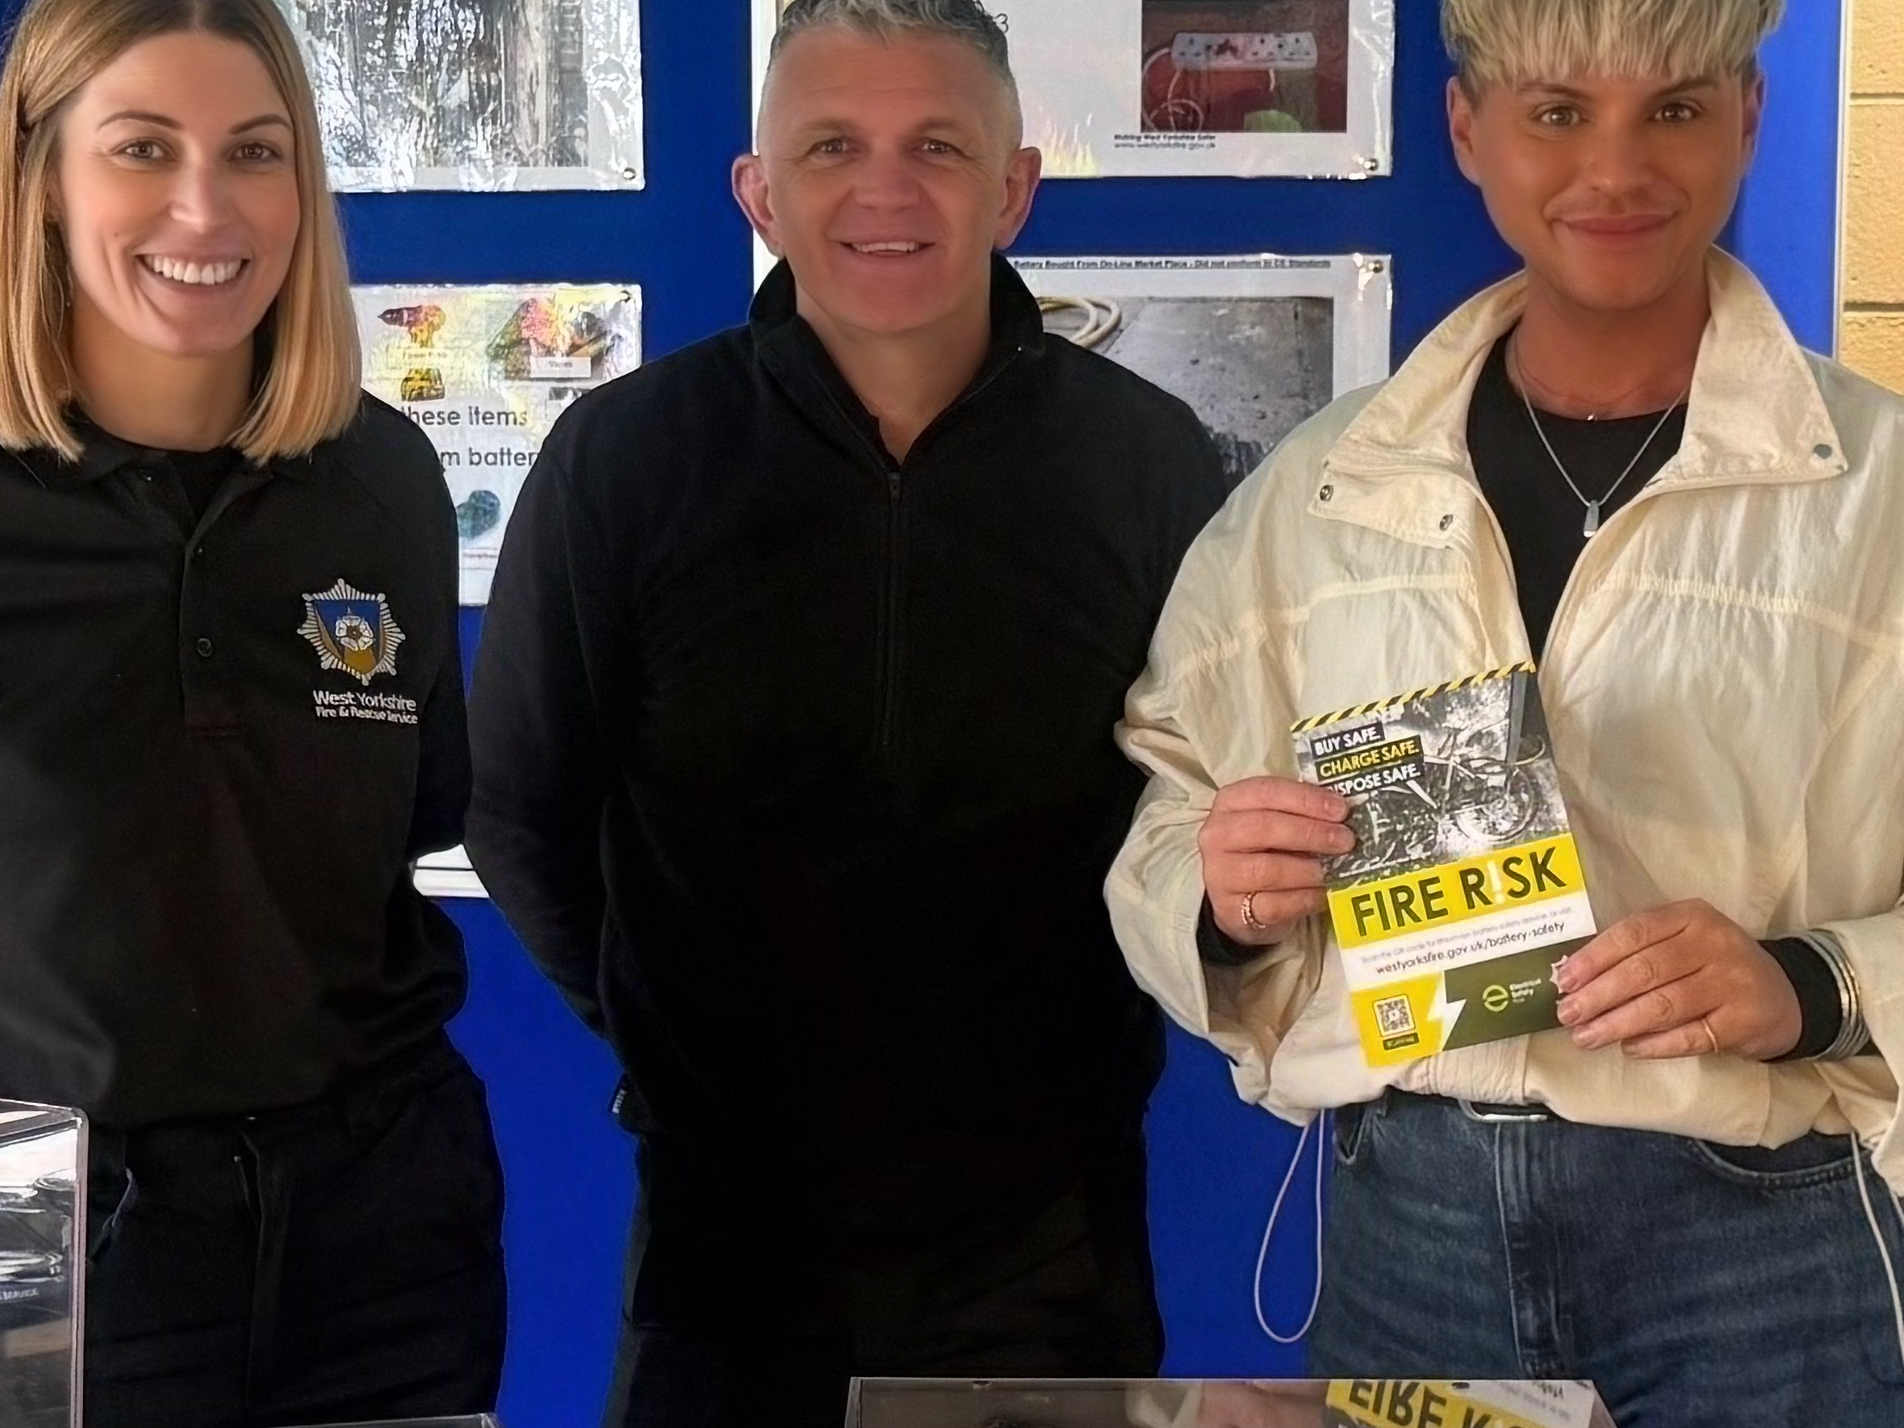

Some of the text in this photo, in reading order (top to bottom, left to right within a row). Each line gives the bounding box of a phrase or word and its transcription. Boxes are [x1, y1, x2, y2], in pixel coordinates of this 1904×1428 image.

[469, 447, 539, 467] batter
[313, 690, 417, 712] West Yorkshire
[315, 705, 336, 718] Fire
[1313, 733, 1341, 757] BUY
[1319, 739, 1419, 778] CHARGE SAFE.
[1383, 762, 1421, 787] SAFE.
[1351, 875, 1448, 938] FIRE
